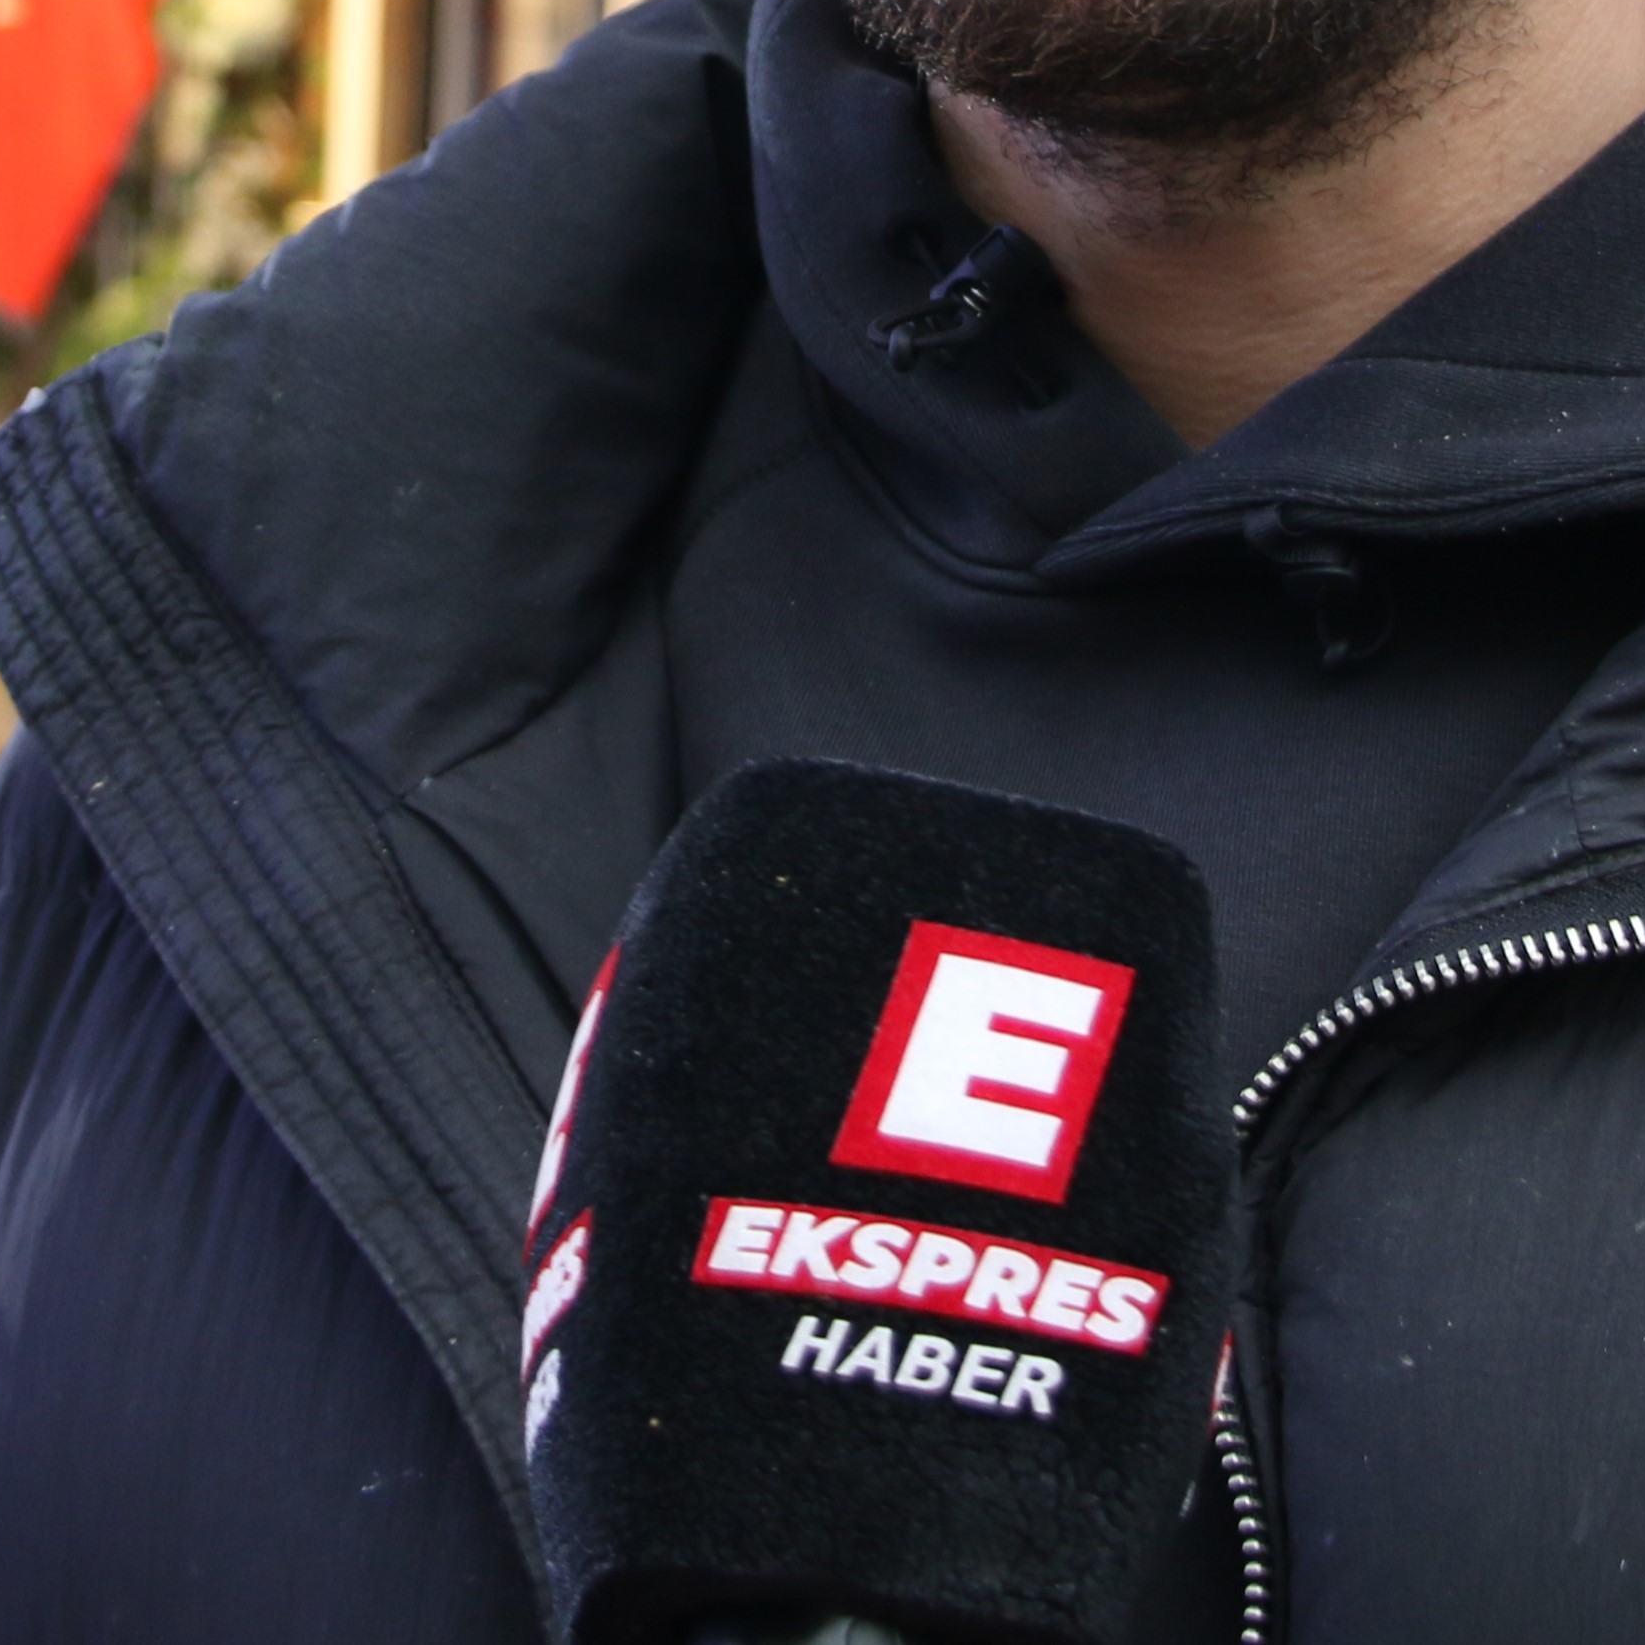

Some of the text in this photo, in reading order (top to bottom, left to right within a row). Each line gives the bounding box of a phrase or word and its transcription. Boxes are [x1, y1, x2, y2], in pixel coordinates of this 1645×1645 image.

[876, 952, 1104, 1168] E
[708, 1204, 1157, 1344] EKSPRES
[780, 1314, 1064, 1416] HABER
